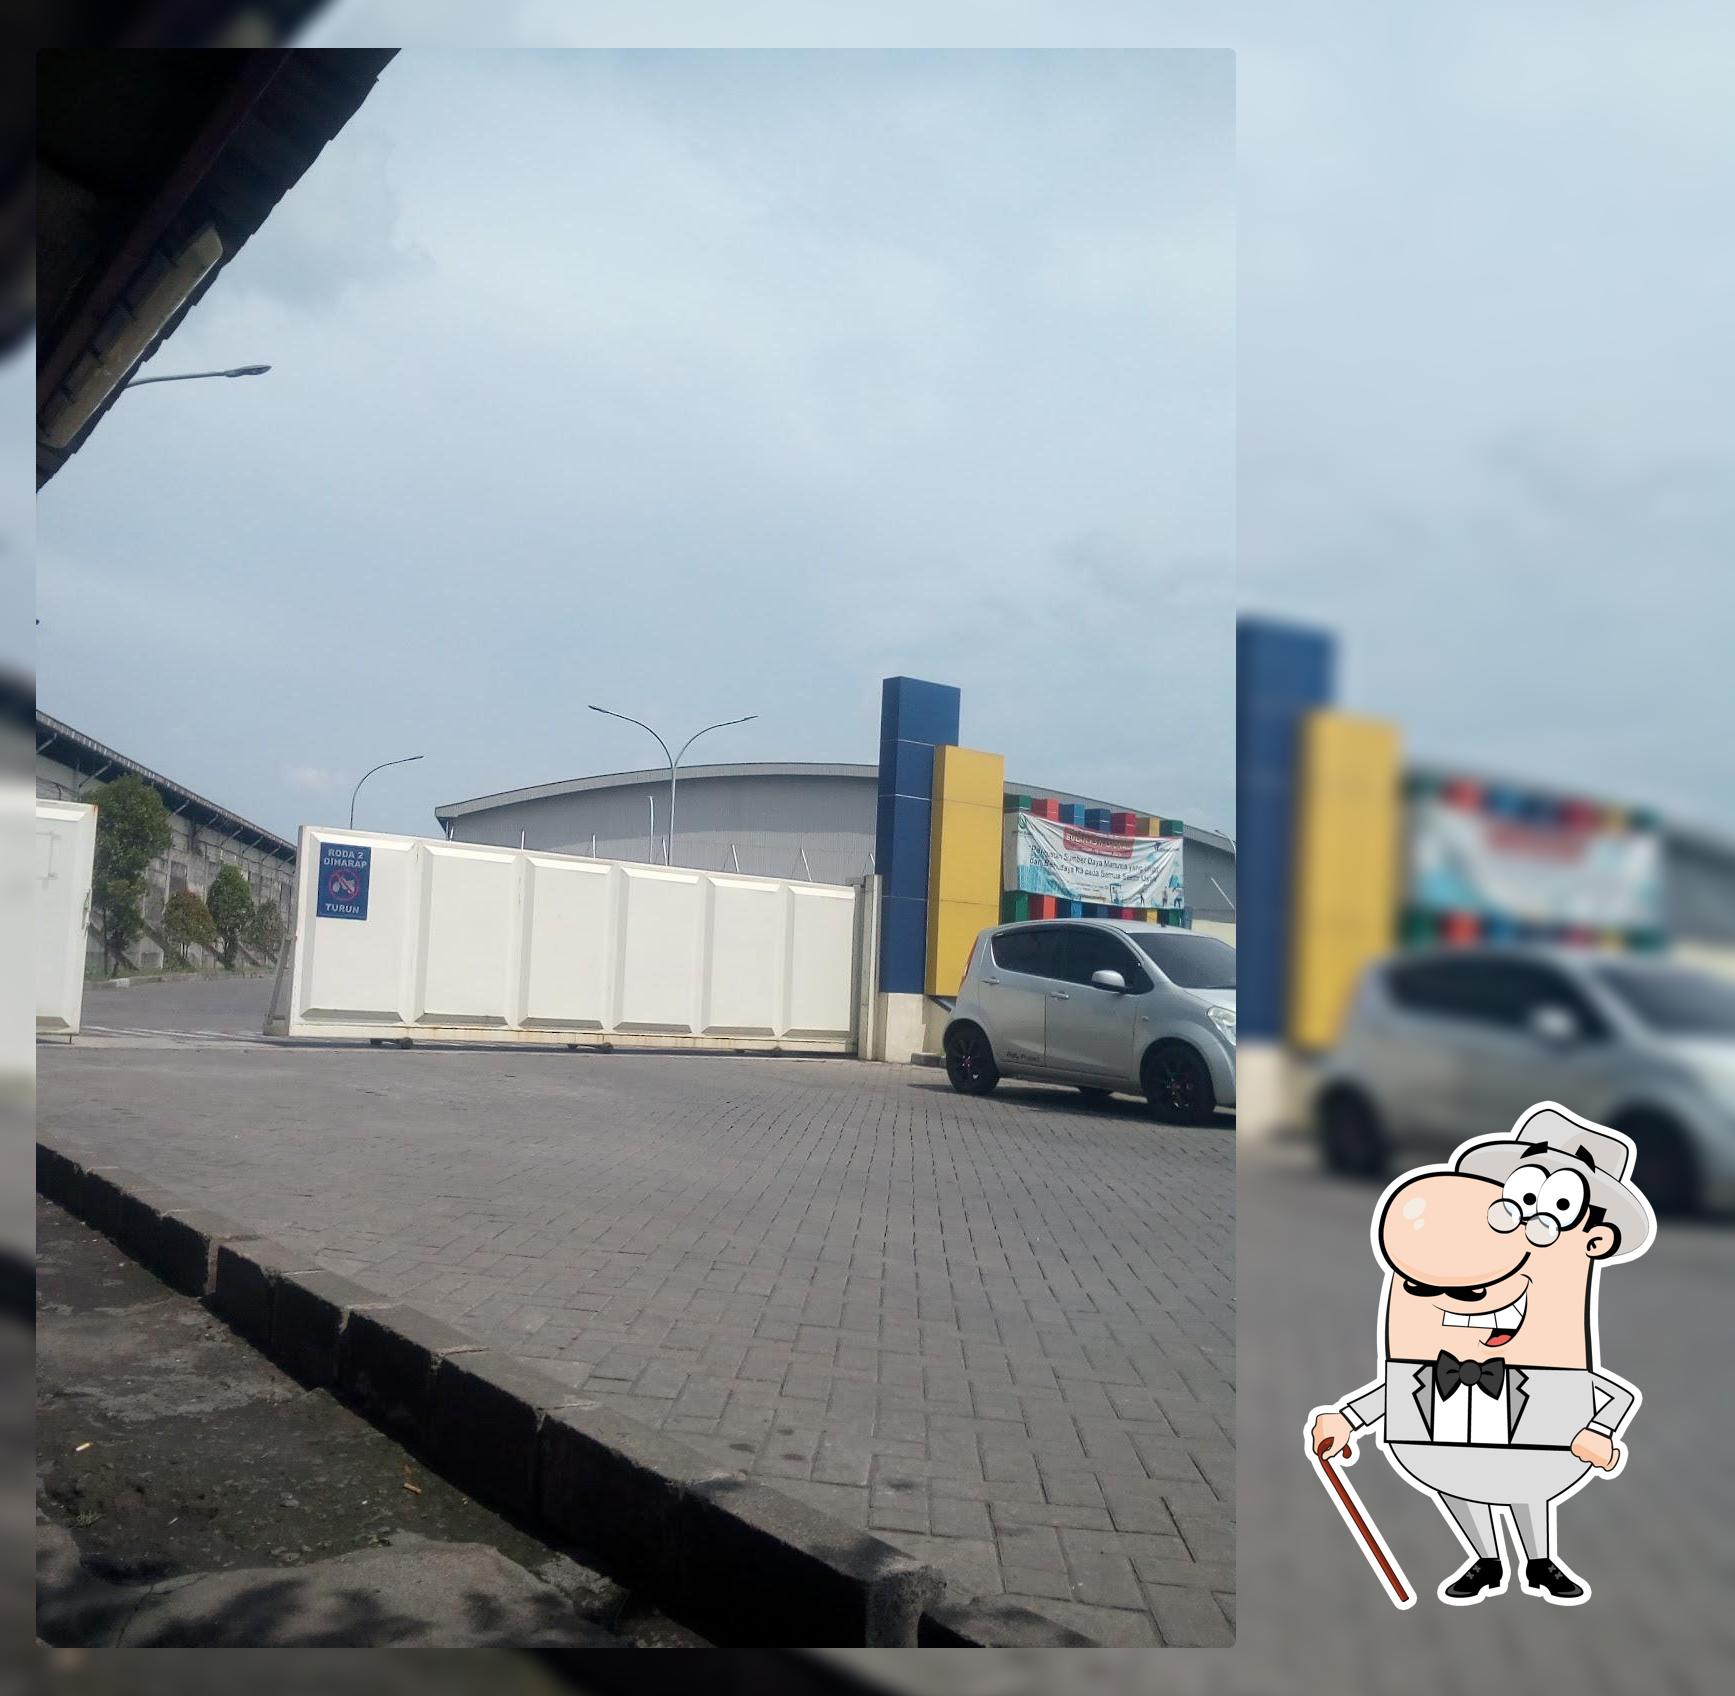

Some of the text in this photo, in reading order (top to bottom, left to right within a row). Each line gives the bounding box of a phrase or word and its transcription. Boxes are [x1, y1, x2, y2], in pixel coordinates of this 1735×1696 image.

[328, 848, 364, 860] RODA 2
[323, 857, 367, 869] DIHARAP
[1088, 857, 1103, 867] Daya
[325, 903, 360, 914] TURUN
